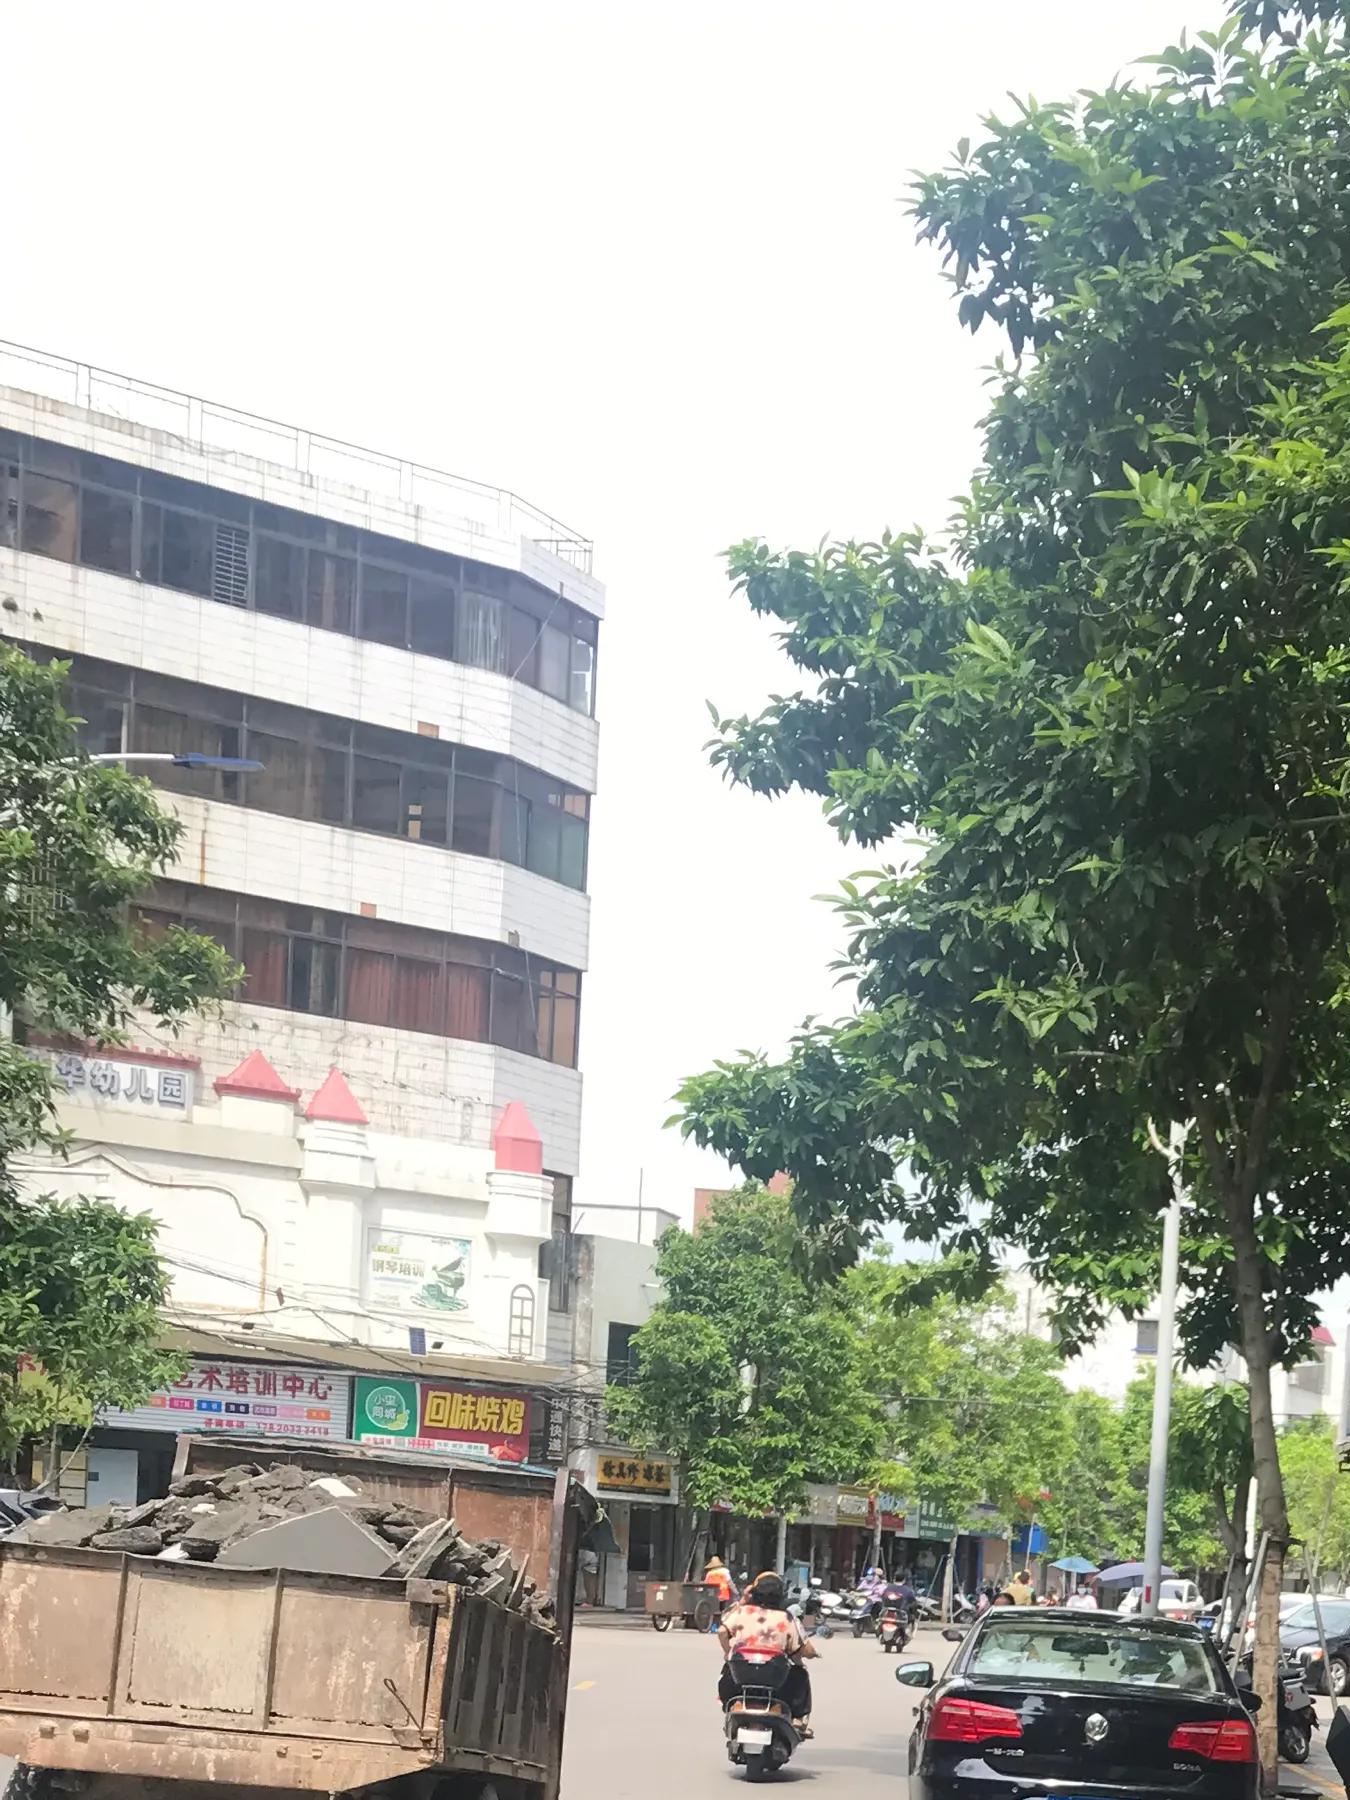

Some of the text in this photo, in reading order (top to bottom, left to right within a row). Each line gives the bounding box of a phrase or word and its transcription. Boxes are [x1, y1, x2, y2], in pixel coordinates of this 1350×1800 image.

[32, 1050, 187, 1107] 华幼儿园
[424, 1390, 525, 1435] 回味烧鸡
